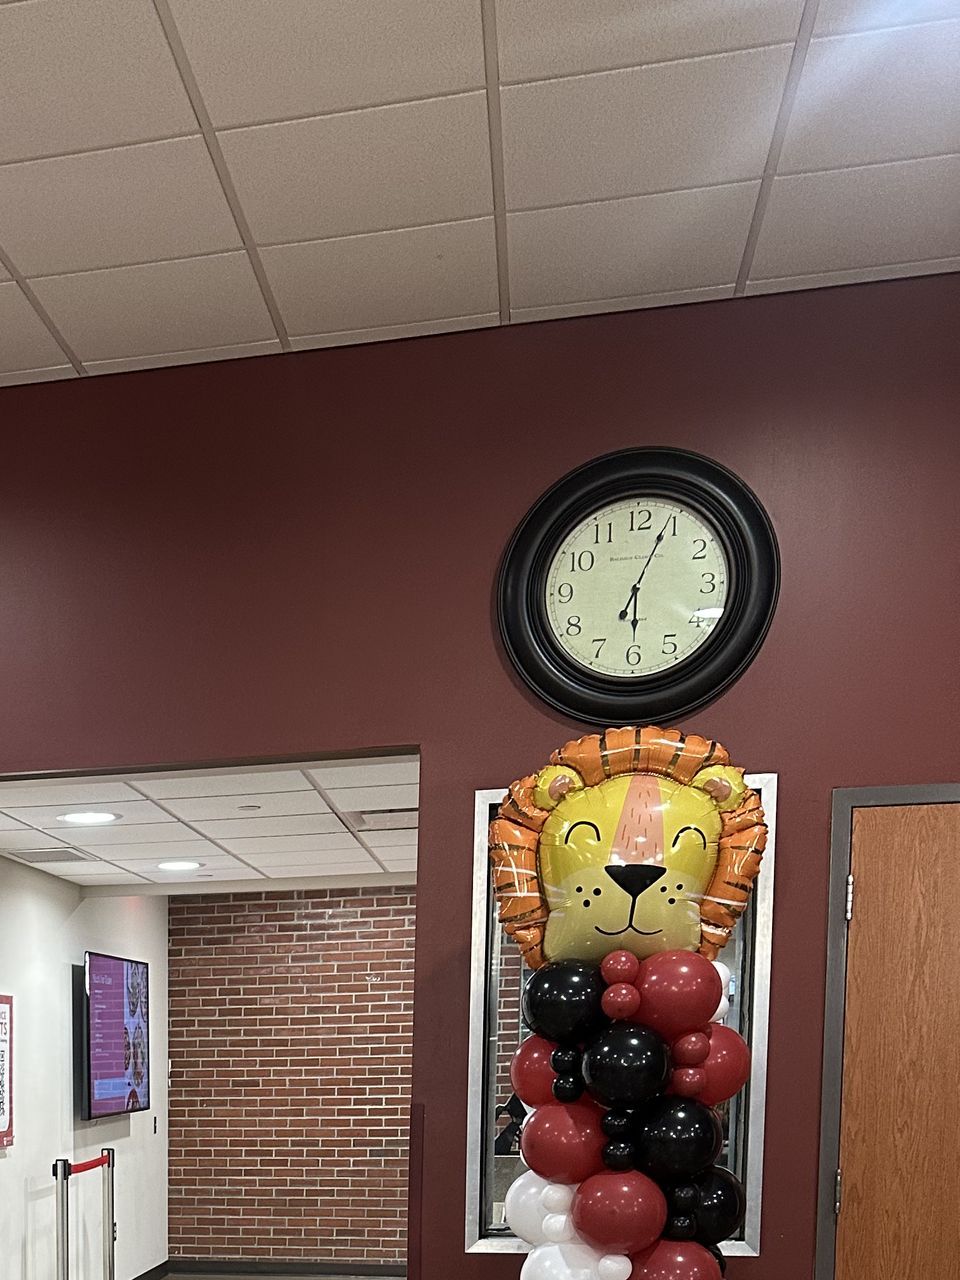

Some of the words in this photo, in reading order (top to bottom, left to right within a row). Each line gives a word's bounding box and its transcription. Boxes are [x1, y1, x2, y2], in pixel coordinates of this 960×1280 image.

[628, 509, 652, 531] 12
[670, 515, 678, 536] 1
[593, 522, 613, 544] 11
[691, 538, 707, 560] 2
[569, 550, 595, 572] 10
[557, 582, 574, 604] 9
[699, 572, 716, 594] 3
[566, 615, 582, 637] 8
[591, 638, 607, 659] 7
[625, 644, 642, 666] 6
[661, 633, 678, 655] 5
